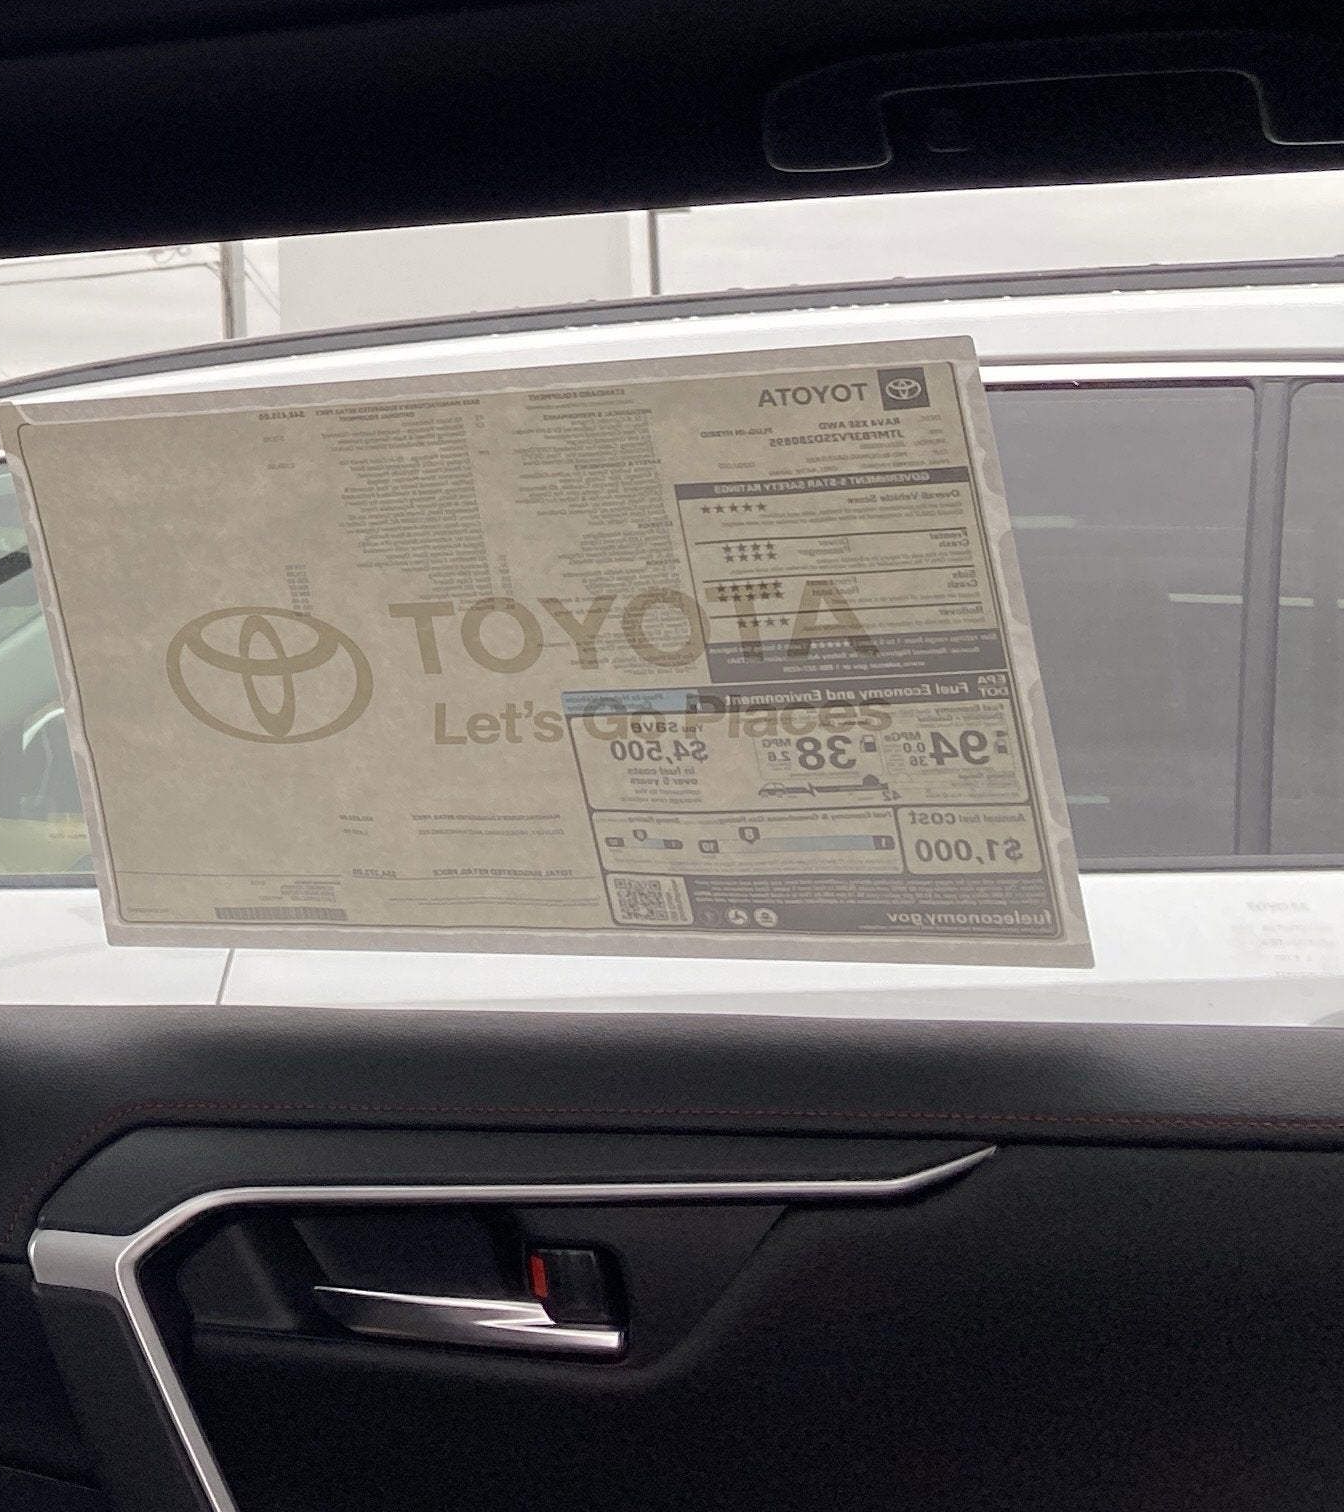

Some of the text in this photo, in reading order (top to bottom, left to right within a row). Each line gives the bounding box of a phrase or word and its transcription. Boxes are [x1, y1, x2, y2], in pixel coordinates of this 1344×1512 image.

[388, 580, 880, 675] TOYOTA
[584, 697, 667, 742] Go
[684, 692, 893, 739] Places
